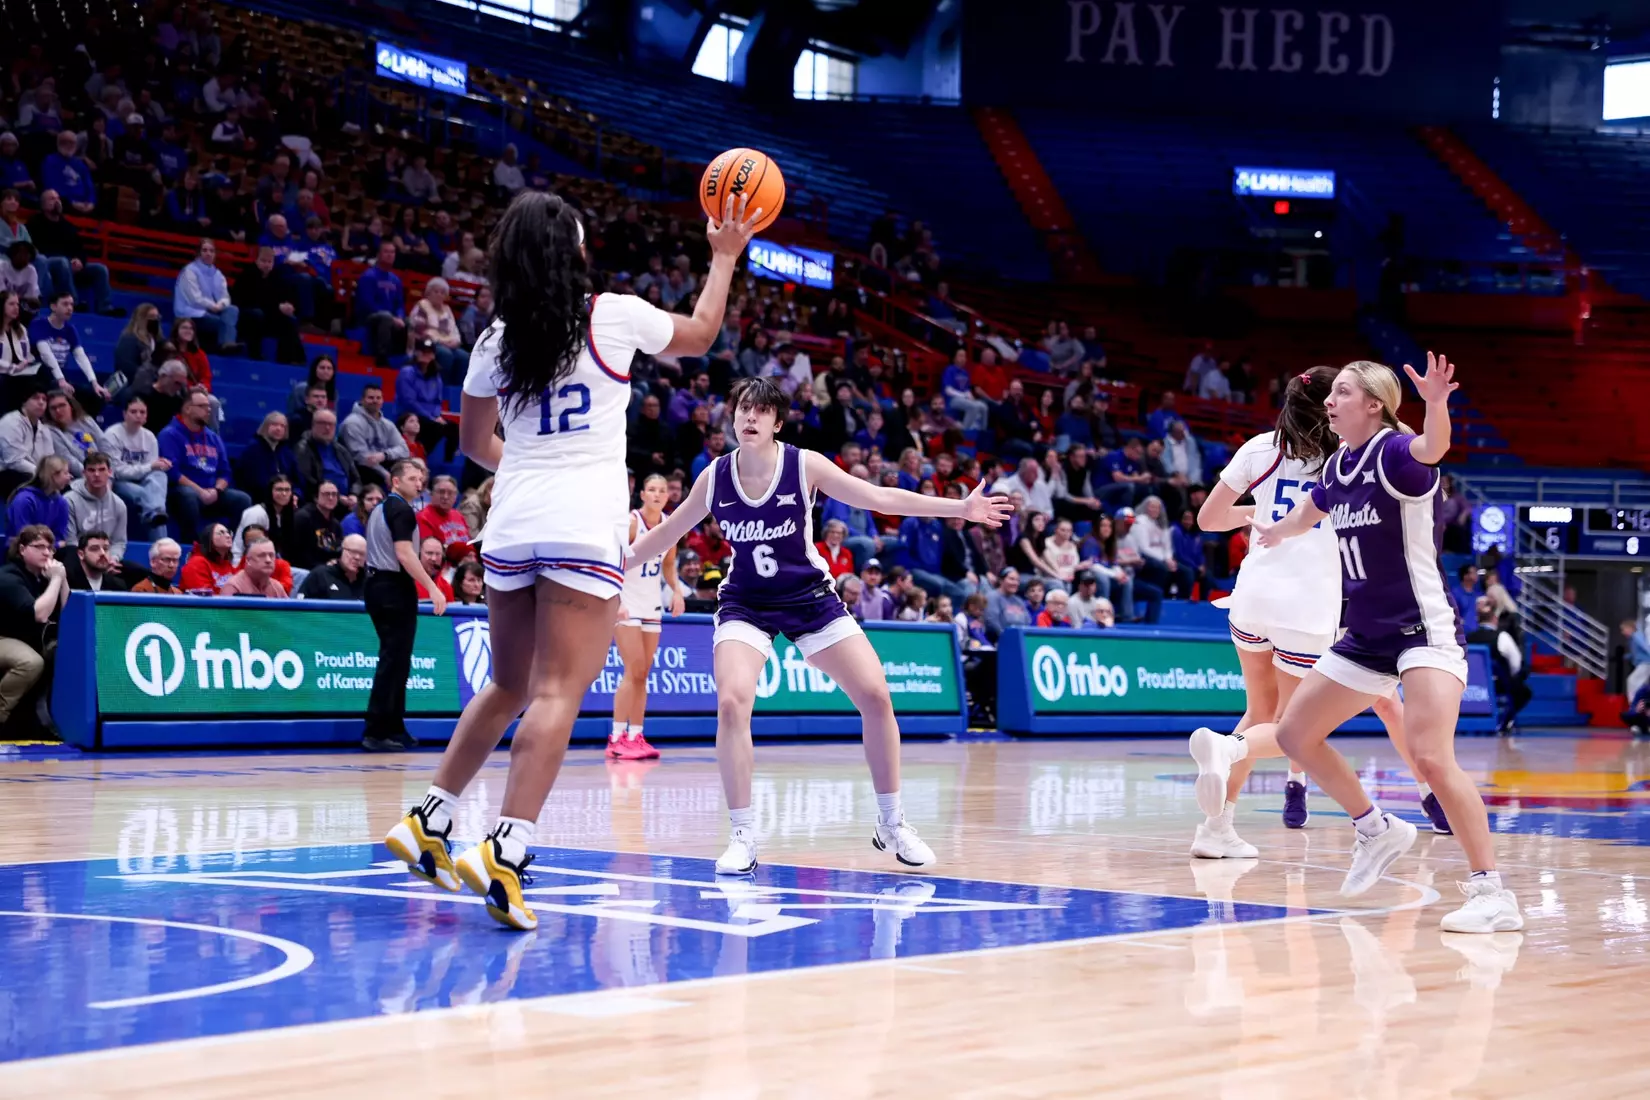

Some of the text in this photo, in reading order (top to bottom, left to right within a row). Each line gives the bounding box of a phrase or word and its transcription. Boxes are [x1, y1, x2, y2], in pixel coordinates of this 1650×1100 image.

[1065, 0, 1394, 77] PAY HEED
[729, 158, 756, 198] NCAA
[537, 383, 591, 436] 12
[720, 517, 797, 542] Wildcats
[640, 559, 662, 578] 13
[752, 543, 779, 578] 6
[1339, 535, 1367, 580] 11
[191, 632, 304, 690] fnbo
[315, 651, 354, 668] Proud
[411, 654, 437, 669] tner
[664, 647, 688, 669] OF
[1066, 652, 1128, 697] fnbo
[317, 673, 331, 689] of
[333, 673, 373, 689] Kansa
[1137, 667, 1175, 689] Proud
[1175, 667, 1207, 689] Bank
